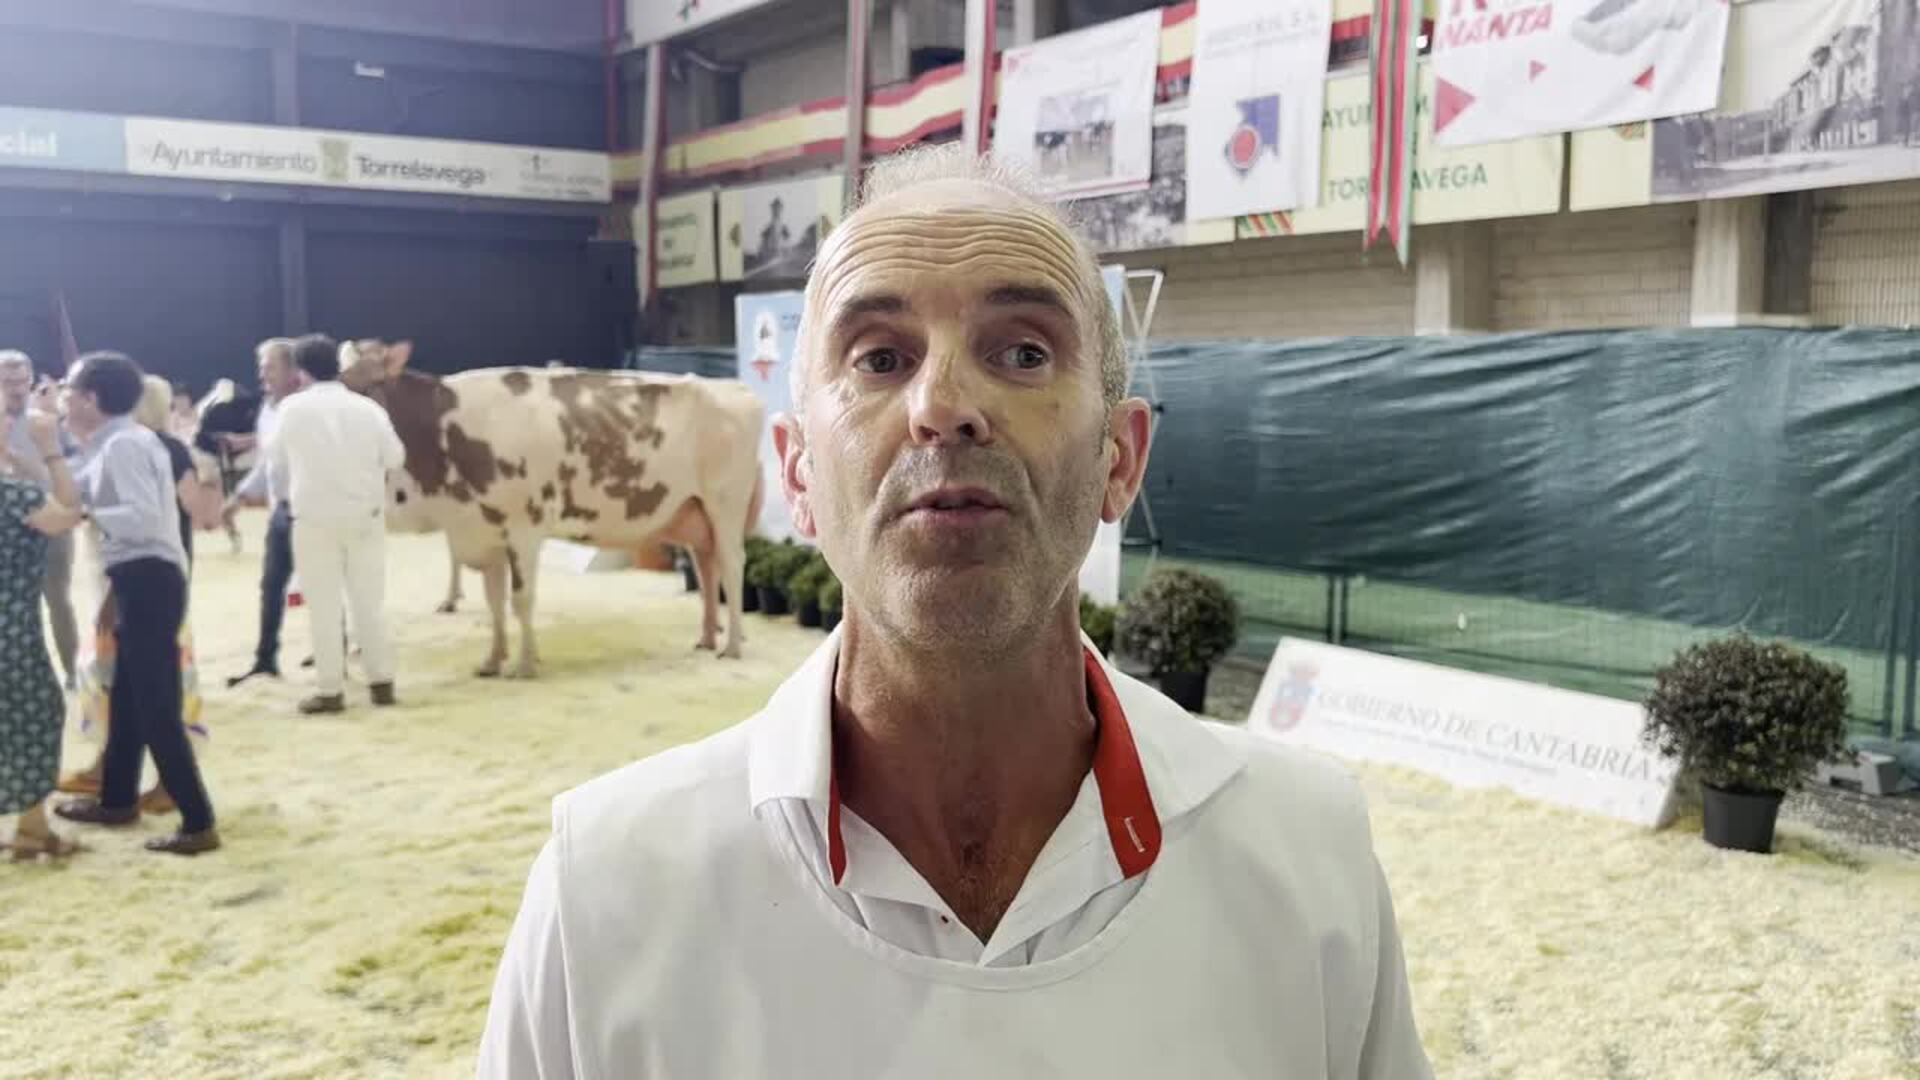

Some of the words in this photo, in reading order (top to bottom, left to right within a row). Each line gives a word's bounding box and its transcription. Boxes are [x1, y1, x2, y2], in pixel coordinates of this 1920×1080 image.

[1439, 6, 1553, 48] NANTA
[151, 138, 318, 174] Ayuntamiento
[356, 154, 487, 187] Torrelavega
[1318, 689, 1440, 730] GOBIERNO
[1446, 714, 1479, 738] DE
[1486, 721, 1652, 781] CANTABRIA
